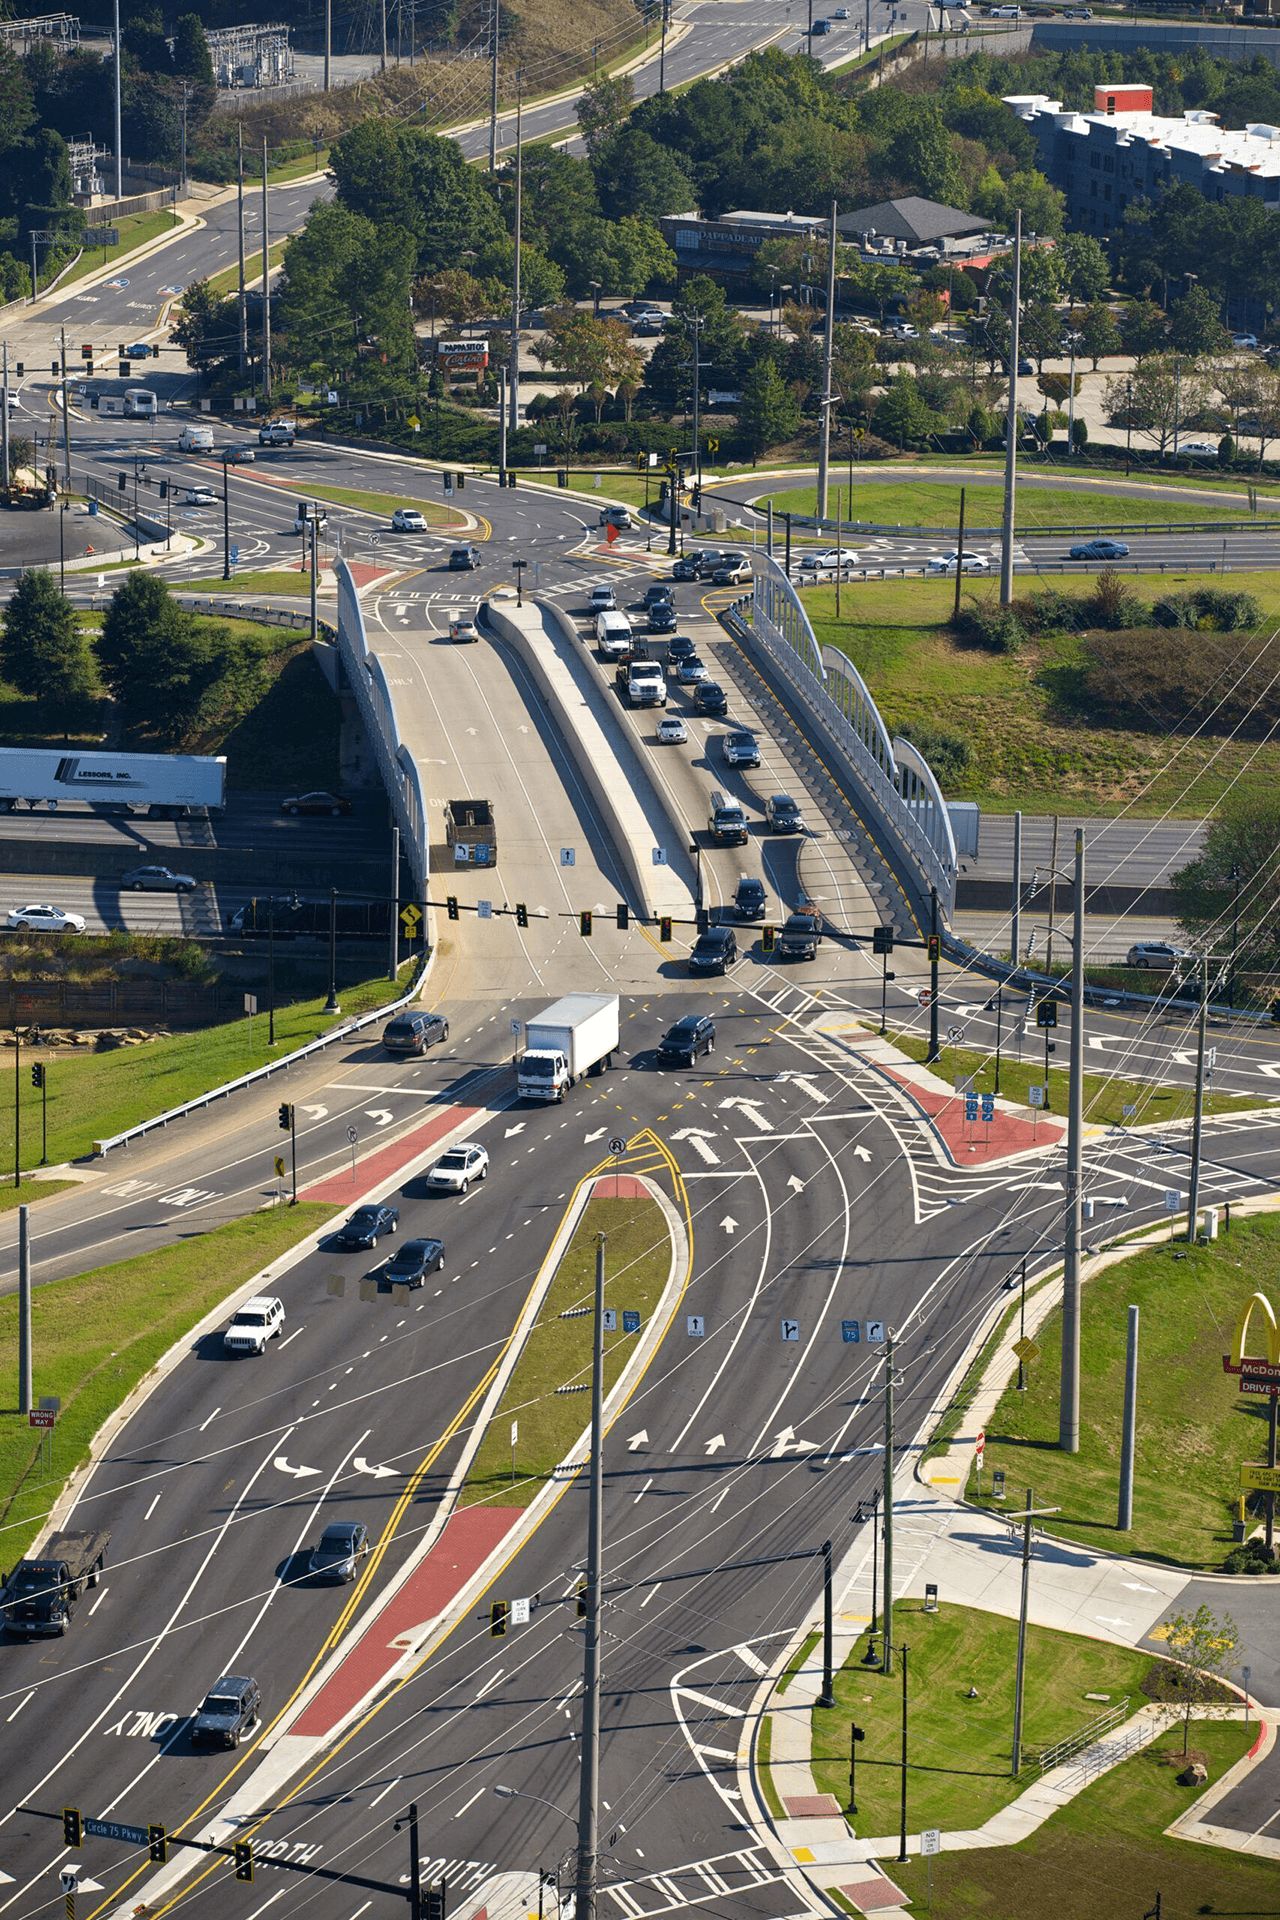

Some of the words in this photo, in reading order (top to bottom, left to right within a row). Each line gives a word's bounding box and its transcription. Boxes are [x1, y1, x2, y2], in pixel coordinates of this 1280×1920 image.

[388, 678, 413, 686] ONLY
[78, 771, 113, 779] LESSORS,
[101, 1180, 166, 1198] ONLY
[157, 1188, 224, 1207] ONLY
[103, 1711, 179, 1738] ONLY
[87, 1822, 107, 1834] Circle
[109, 1825, 118, 1836] 75
[121, 1828, 141, 1843] Pkwy
[399, 1856, 497, 1891] SOUTH
